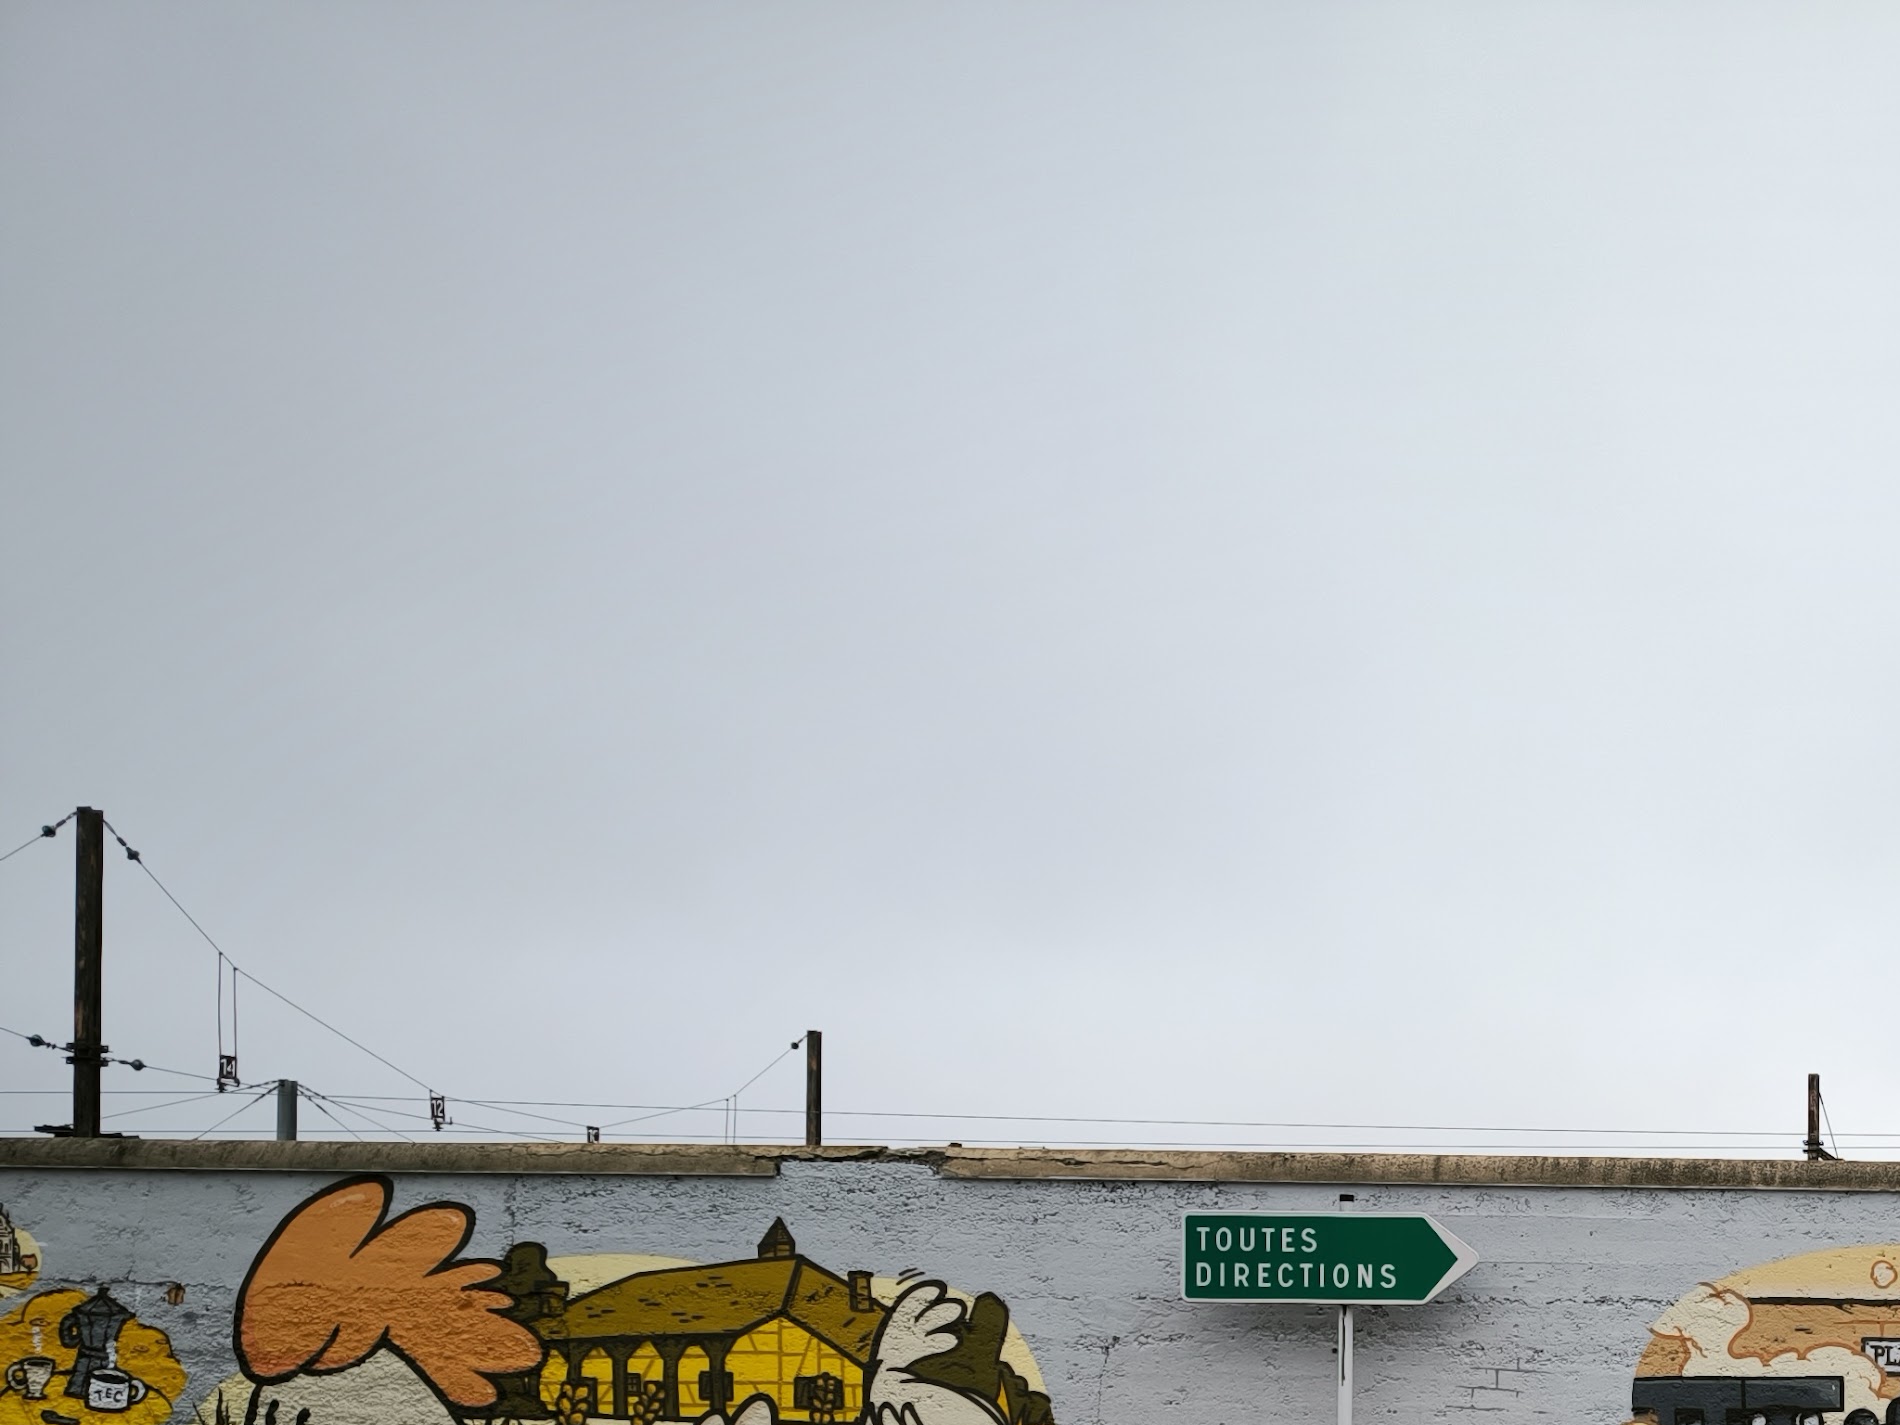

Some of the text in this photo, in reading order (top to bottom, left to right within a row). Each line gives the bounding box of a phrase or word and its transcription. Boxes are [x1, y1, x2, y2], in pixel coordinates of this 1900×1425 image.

[220, 1058, 236, 1077] 14
[431, 1100, 444, 1116] 12
[1196, 1226, 1318, 1252] TOUTES
[1195, 1262, 1397, 1289] DIRECTIONS
[94, 1387, 124, 1403] TEC
